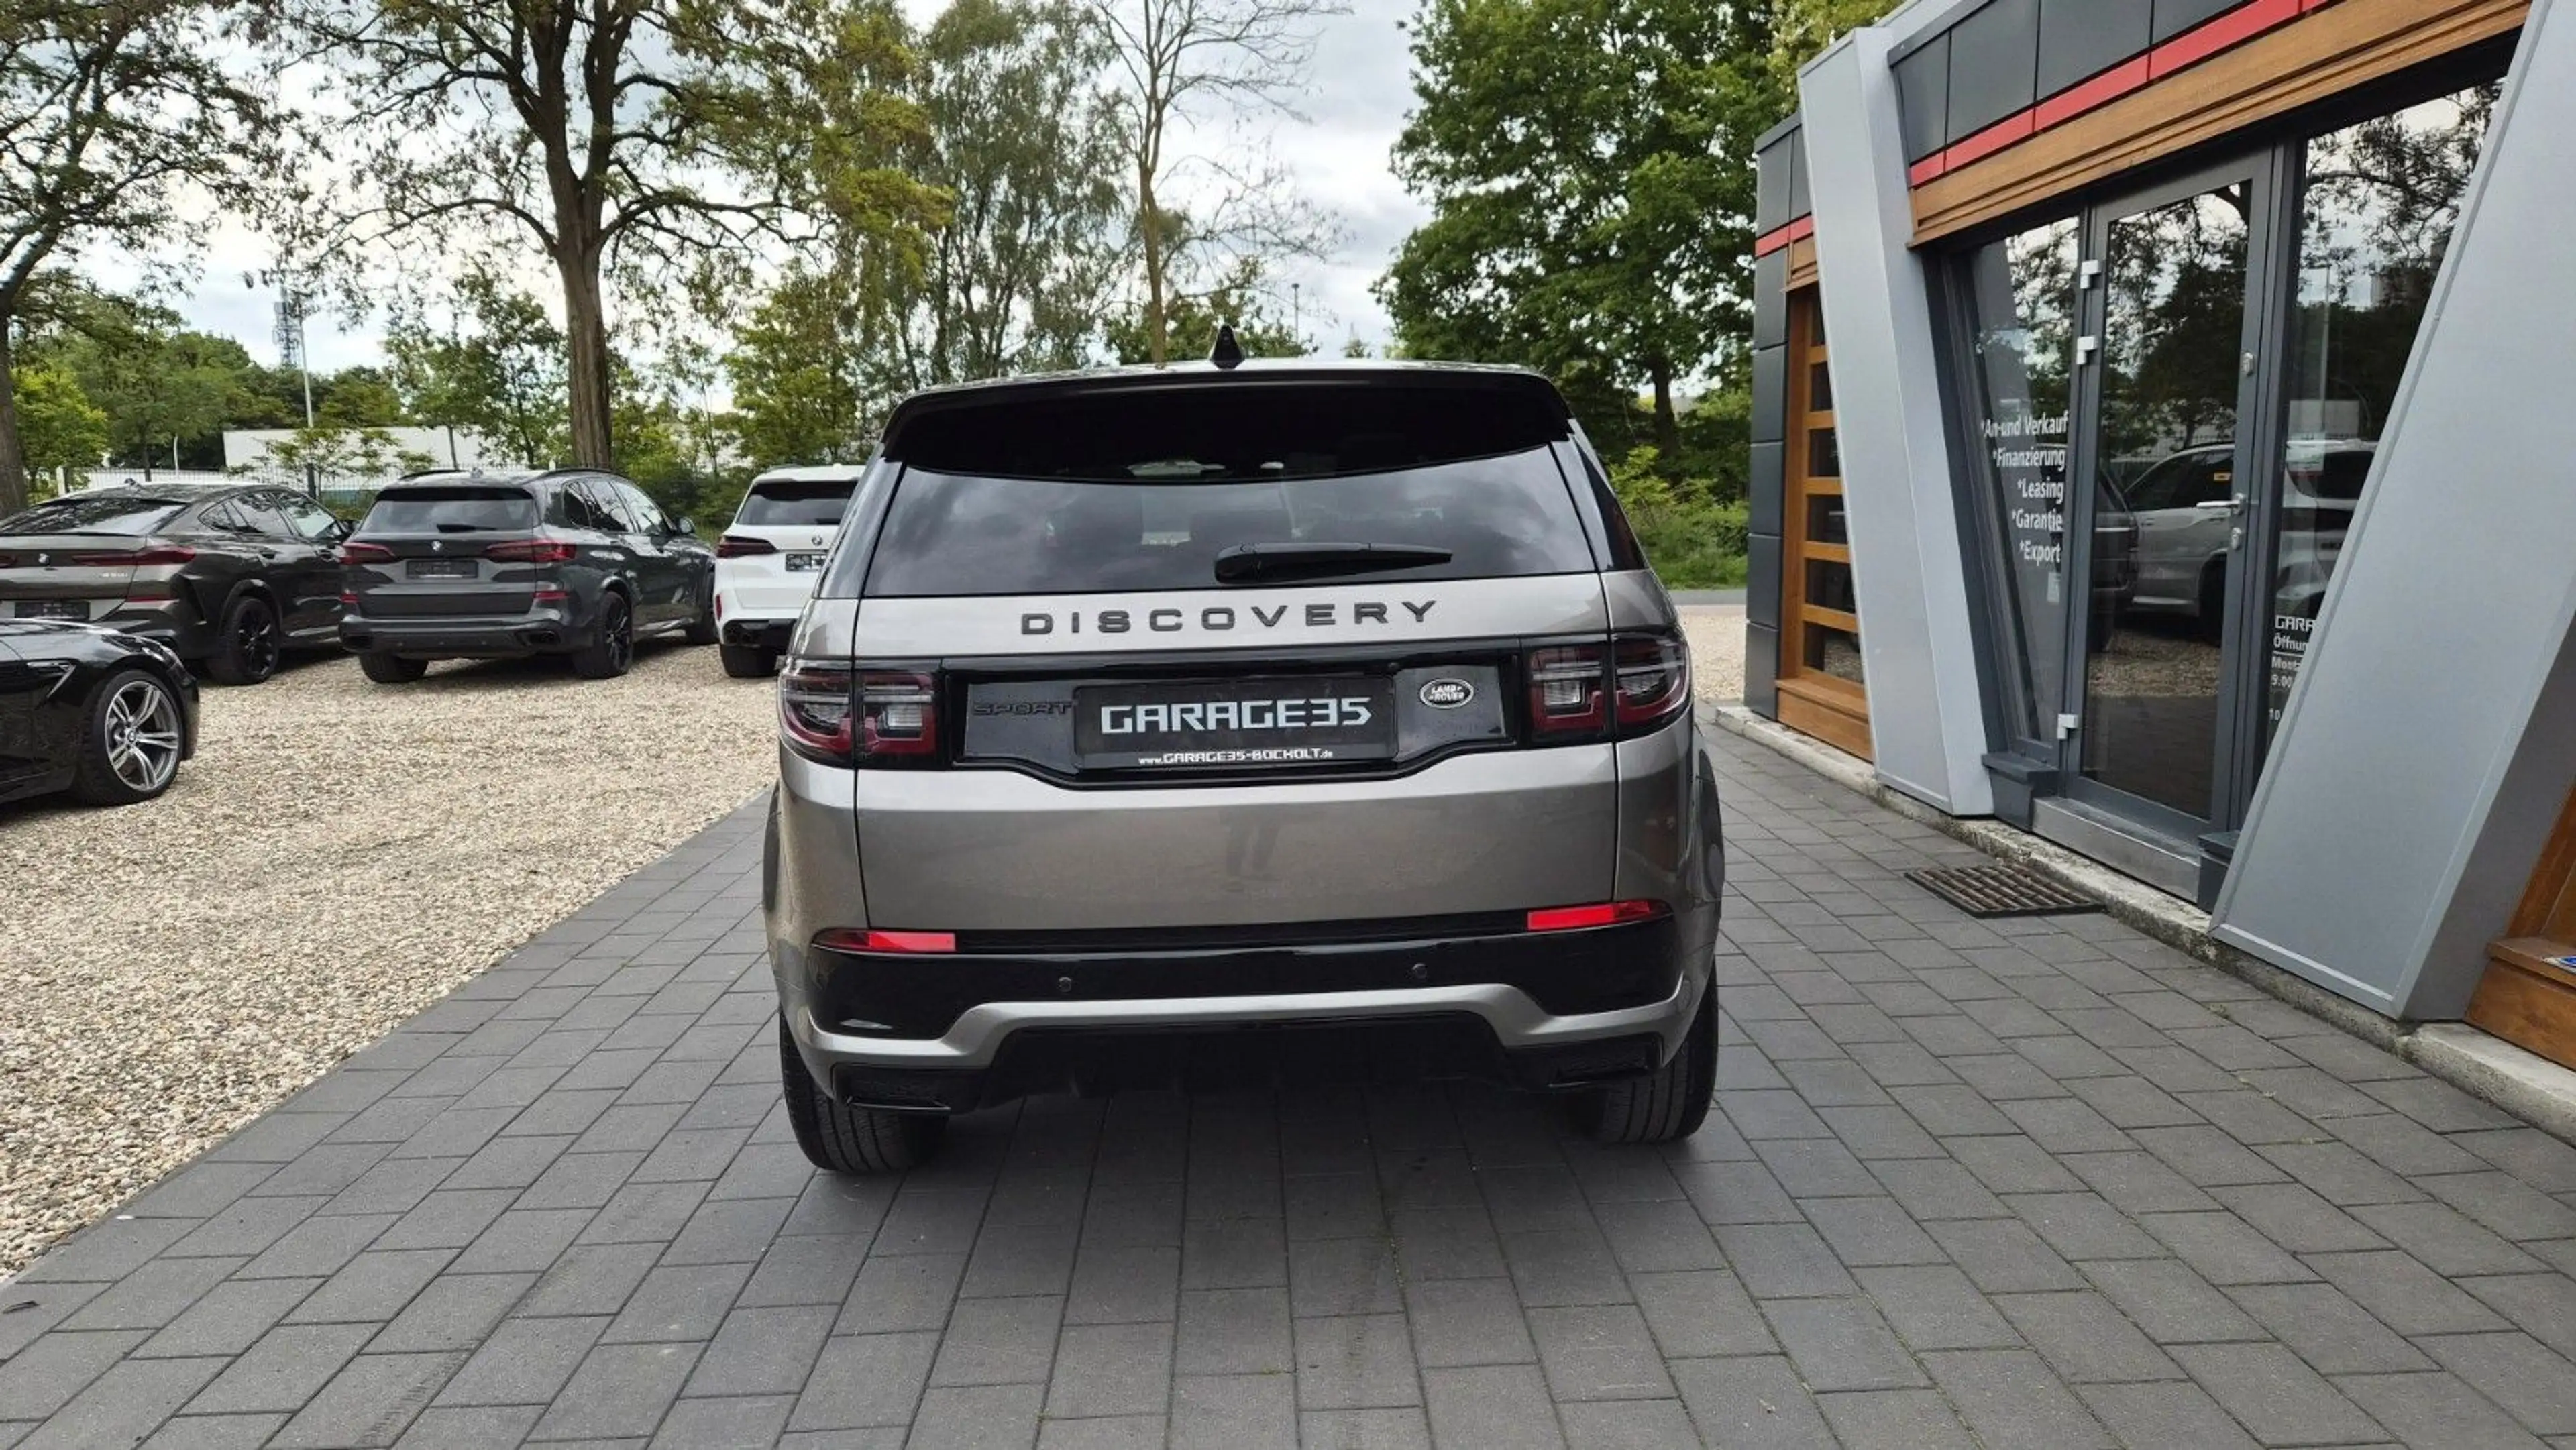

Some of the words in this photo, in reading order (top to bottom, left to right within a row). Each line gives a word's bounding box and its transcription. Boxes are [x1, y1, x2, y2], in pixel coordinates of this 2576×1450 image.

[2025, 410, 2068, 435] Verkauf
[1021, 600, 1436, 634] DISCOVERY
[973, 700, 1073, 716] SPORT
[1101, 697, 1372, 734] GARAGE35
[1138, 748, 1333, 765] www.GARAGE35-BOCHOLT.de
